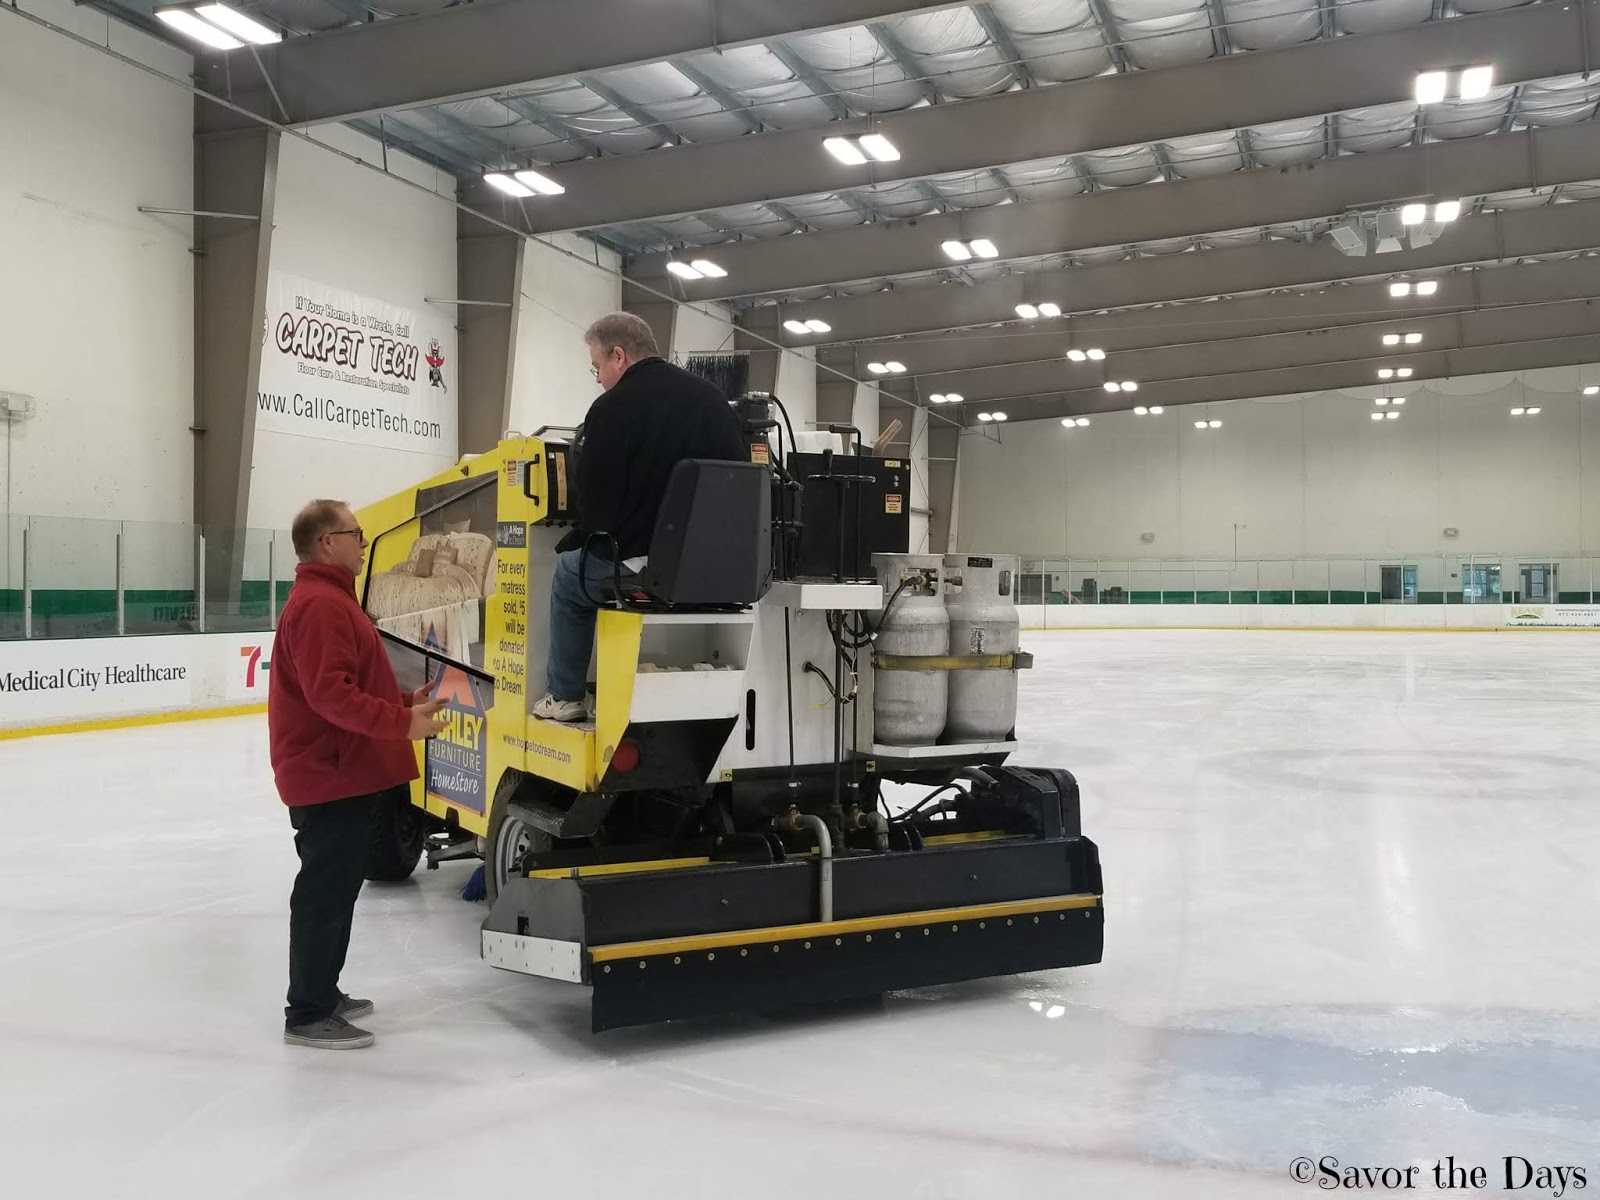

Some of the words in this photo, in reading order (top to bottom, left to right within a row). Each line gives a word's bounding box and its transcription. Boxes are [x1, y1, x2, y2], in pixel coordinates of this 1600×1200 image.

[296, 296, 303, 309] If
[304, 298, 324, 316] Your
[326, 304, 350, 322] Home
[352, 311, 359, 325] is
[360, 316, 366, 327] a
[367, 316, 394, 336] Wreck,
[395, 324, 409, 338] Call
[276, 312, 364, 369] CARPET
[369, 336, 418, 381] TECH
[298, 362, 316, 375] Floor
[317, 366, 333, 380] Care
[334, 370, 341, 380] &
[341, 371, 378, 389] Restoration
[379, 380, 409, 395] Specialists
[513, 525, 524, 537] Hope
[497, 559, 508, 574] For
[509, 563, 526, 578] every
[500, 580, 525, 595] matress
[503, 600, 518, 617] sold,
[505, 619, 515, 634] will
[517, 620, 524, 635] be
[500, 637, 524, 656] donated
[0, 669, 64, 692] Medical
[67, 668, 101, 692] City
[104, 664, 187, 685] Healthcare
[501, 657, 506, 672] A
[508, 657, 524, 678] Hope
[502, 676, 523, 696] Dream.
[432, 708, 483, 751] SHLEY
[429, 740, 481, 771] FURNITURE
[431, 768, 479, 794] HomeStore
